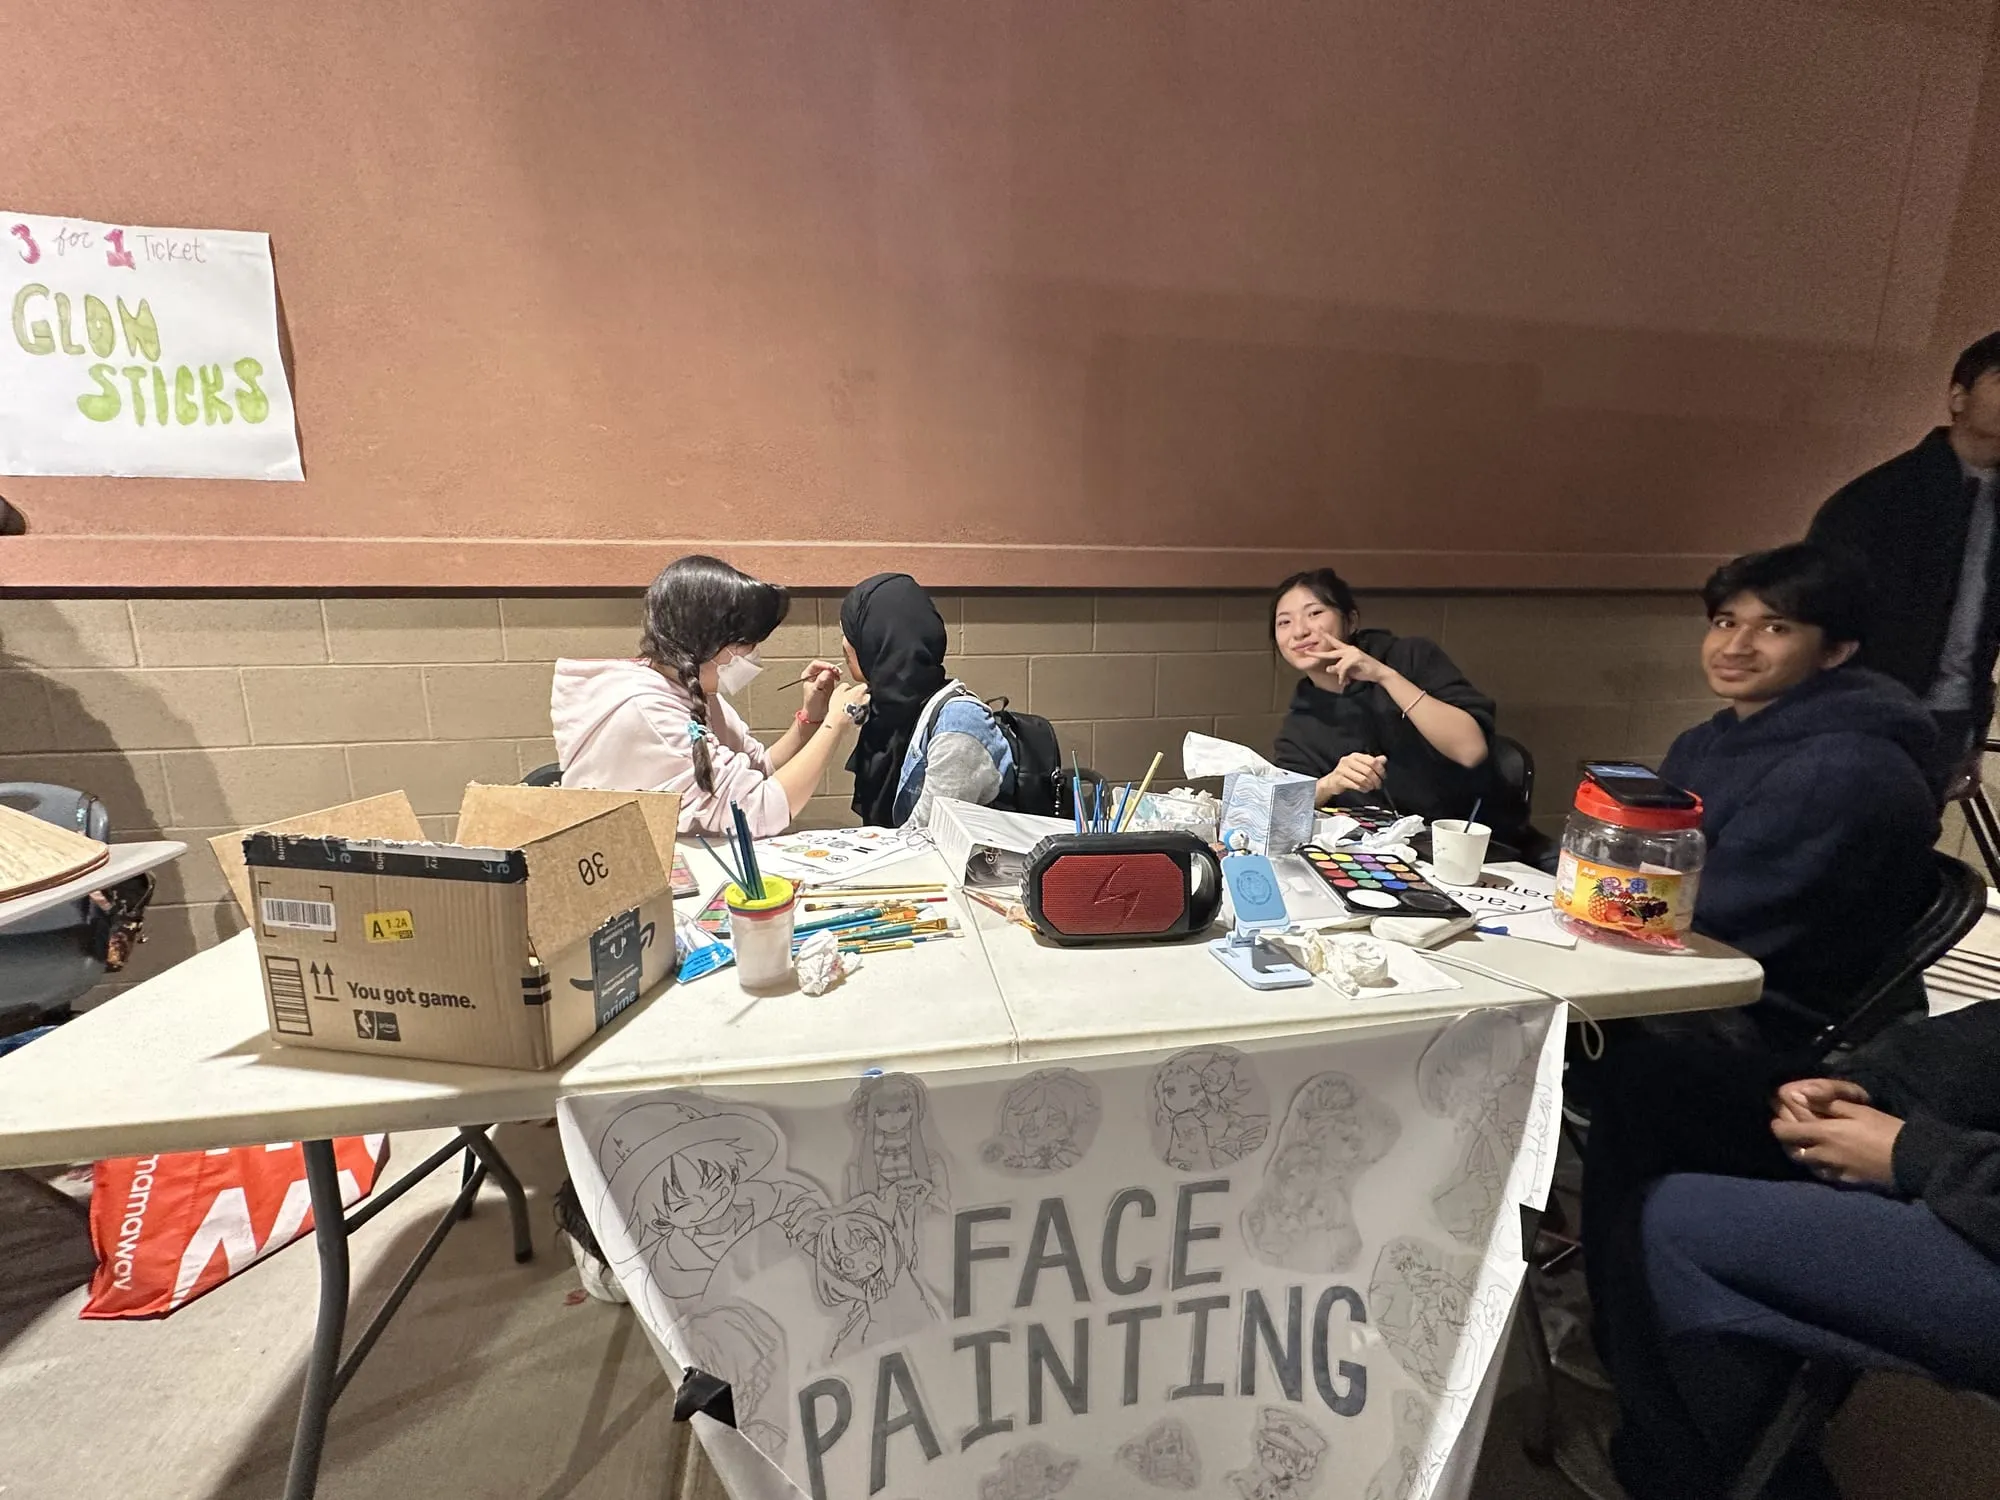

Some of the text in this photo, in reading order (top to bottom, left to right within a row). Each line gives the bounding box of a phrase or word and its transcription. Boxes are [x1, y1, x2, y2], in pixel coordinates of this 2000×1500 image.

[10, 223, 207, 270] 3 for 1 Ticket
[76, 357, 270, 426] STICKS
[373, 919, 385, 938] A
[347, 981, 476, 1009] You got game.
[953, 1179, 1230, 1319] FACE
[799, 1285, 1367, 1500] PAINTING
